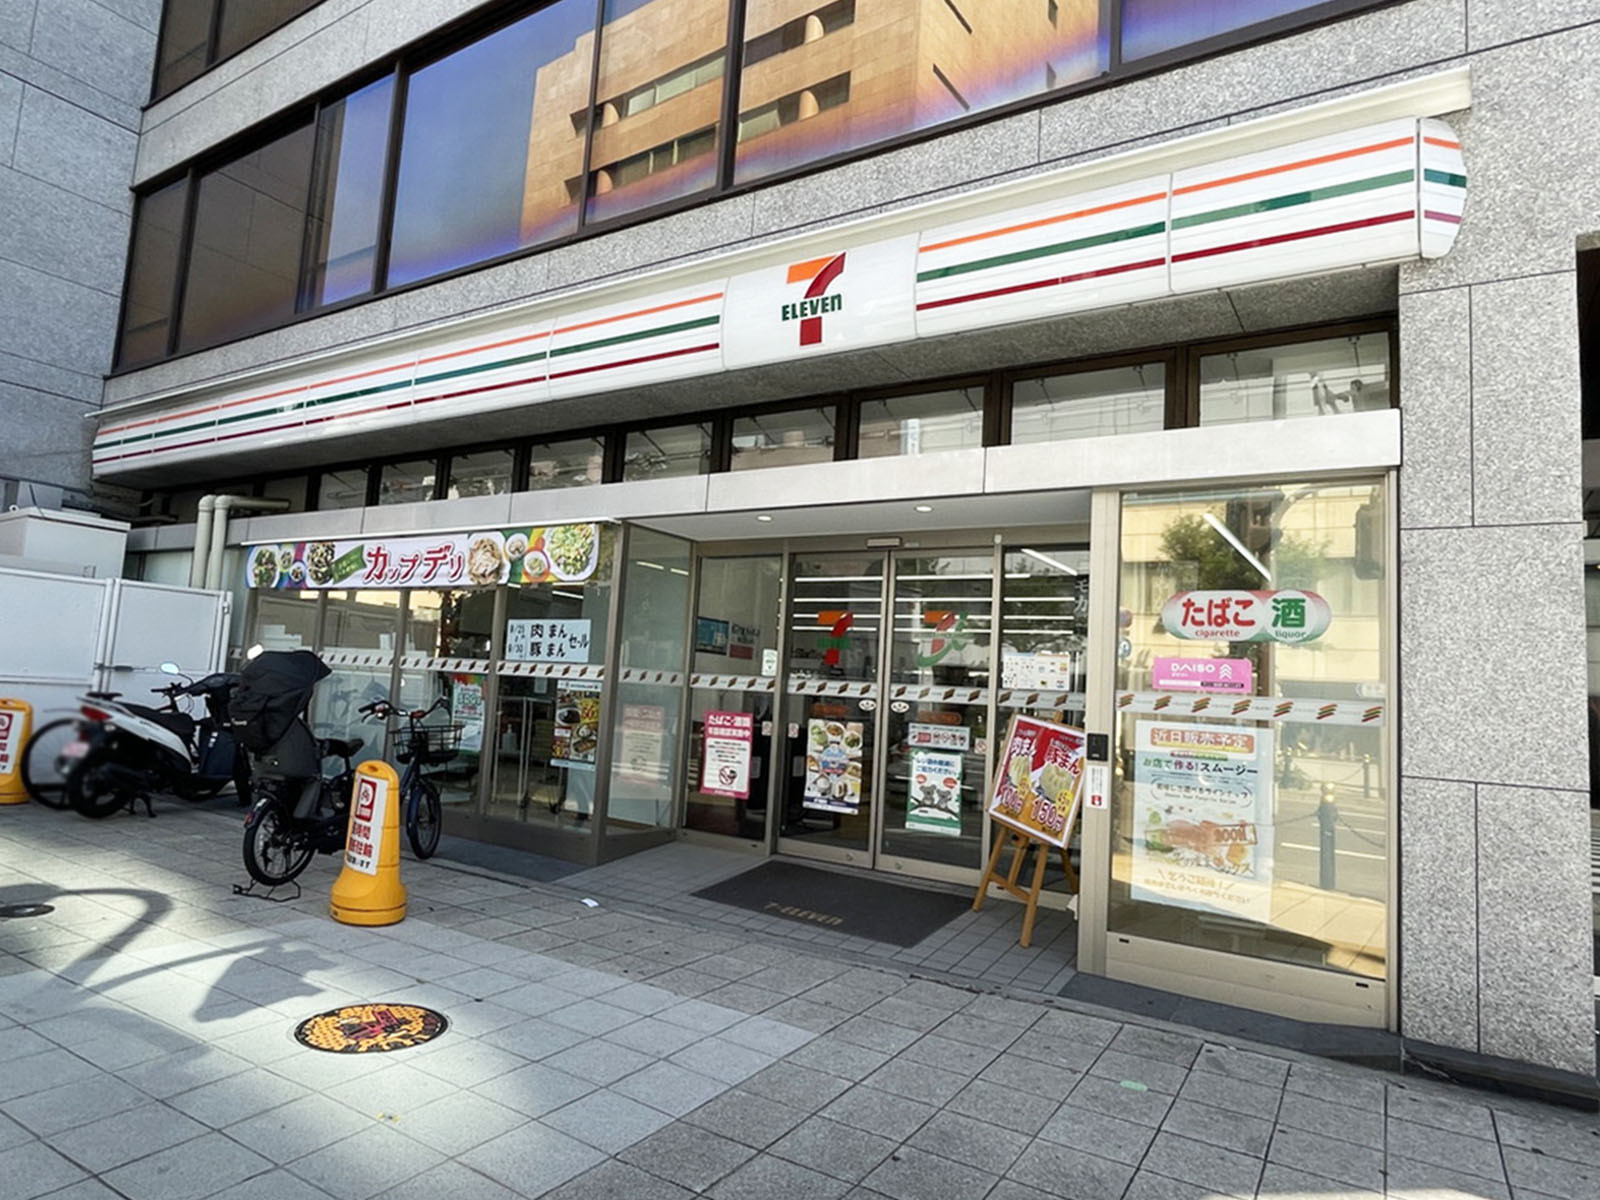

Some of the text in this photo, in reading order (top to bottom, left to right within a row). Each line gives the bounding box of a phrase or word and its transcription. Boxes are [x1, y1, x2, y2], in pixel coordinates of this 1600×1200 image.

[786, 251, 847, 346] 7
[364, 545, 463, 581] カップデリ
[1181, 597, 1307, 629] たばこ 酒
[1194, 629, 1307, 640] cigarette liquor
